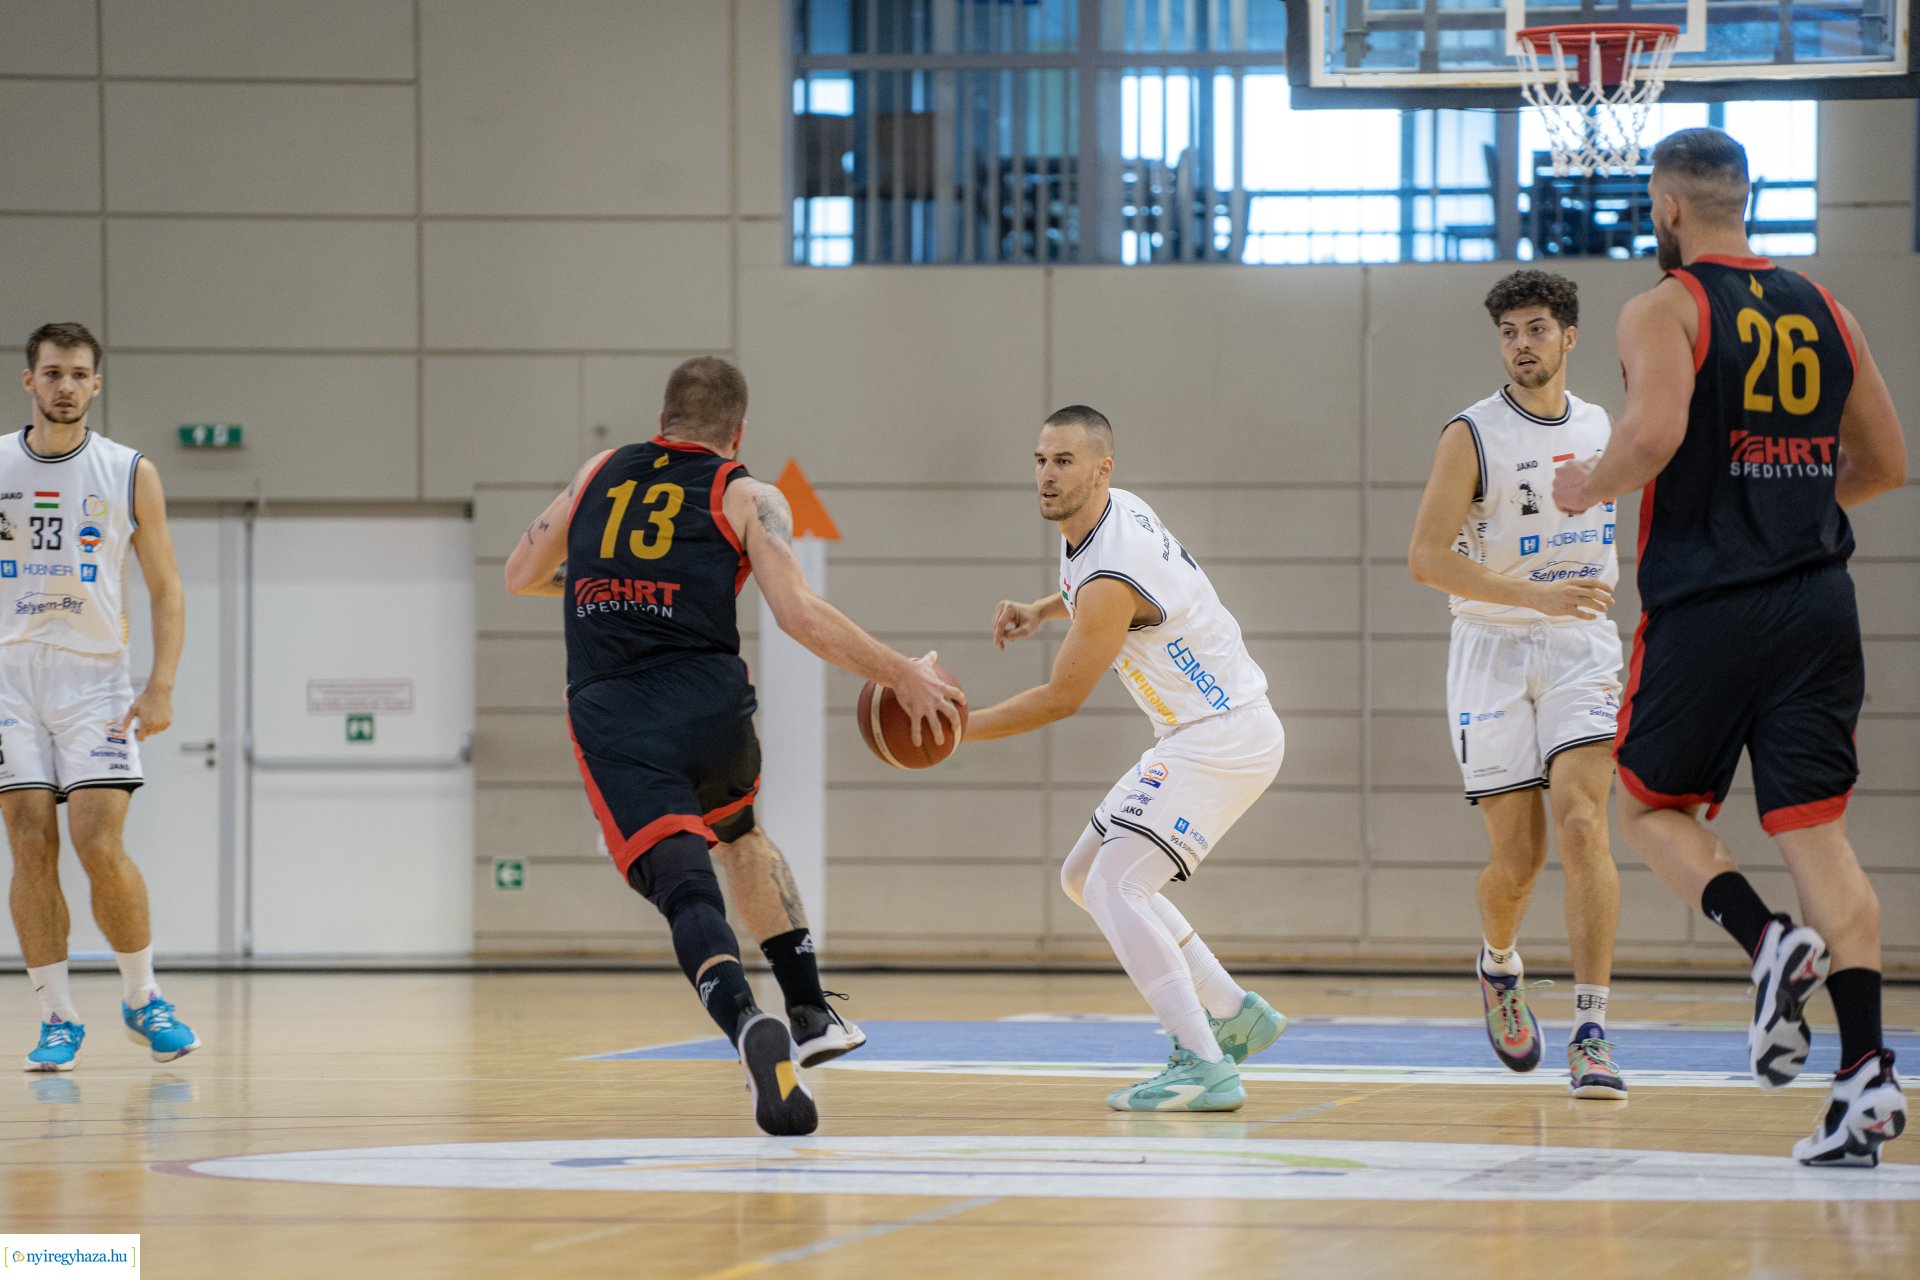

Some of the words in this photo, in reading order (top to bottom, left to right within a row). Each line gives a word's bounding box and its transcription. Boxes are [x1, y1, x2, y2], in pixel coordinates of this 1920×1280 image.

[1736, 307, 1821, 416] 26
[1516, 460, 1539, 472] JAKO
[1730, 461, 1834, 478] SPEDITION
[29, 516, 63, 550] 33
[600, 479, 685, 560] 13
